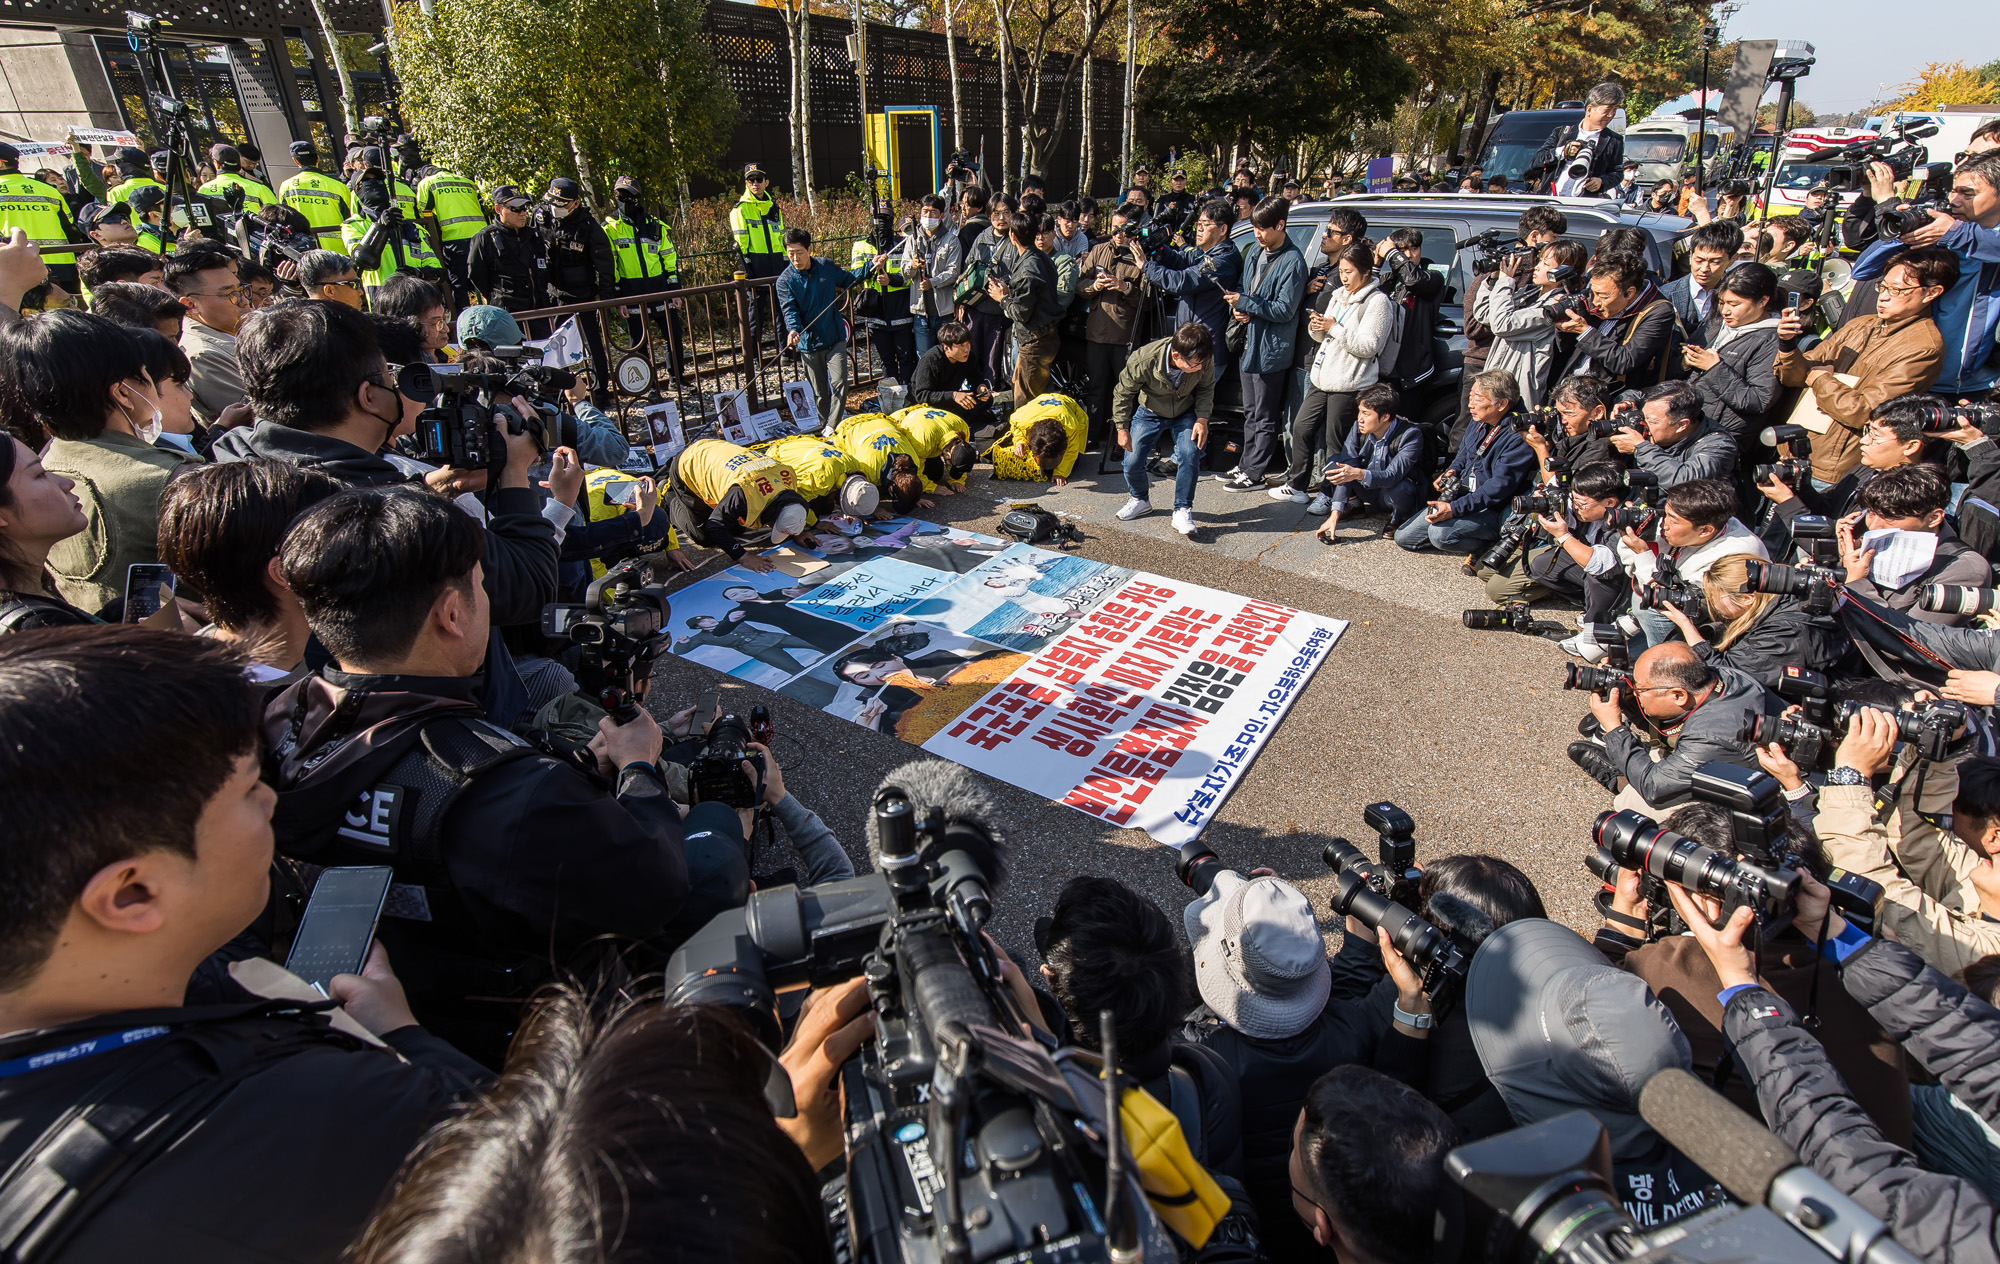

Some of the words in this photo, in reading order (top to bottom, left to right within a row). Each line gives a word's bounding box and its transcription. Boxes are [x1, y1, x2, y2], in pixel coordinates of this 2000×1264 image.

[292, 178, 320, 189] 경찰
[438, 186, 473, 195] POLICE
[0, 204, 51, 212] POLICE
[1132, 606, 1223, 659] 가로막는
[1211, 599, 1298, 657] 규탄한다!
[1027, 635, 1113, 685] 납북자
